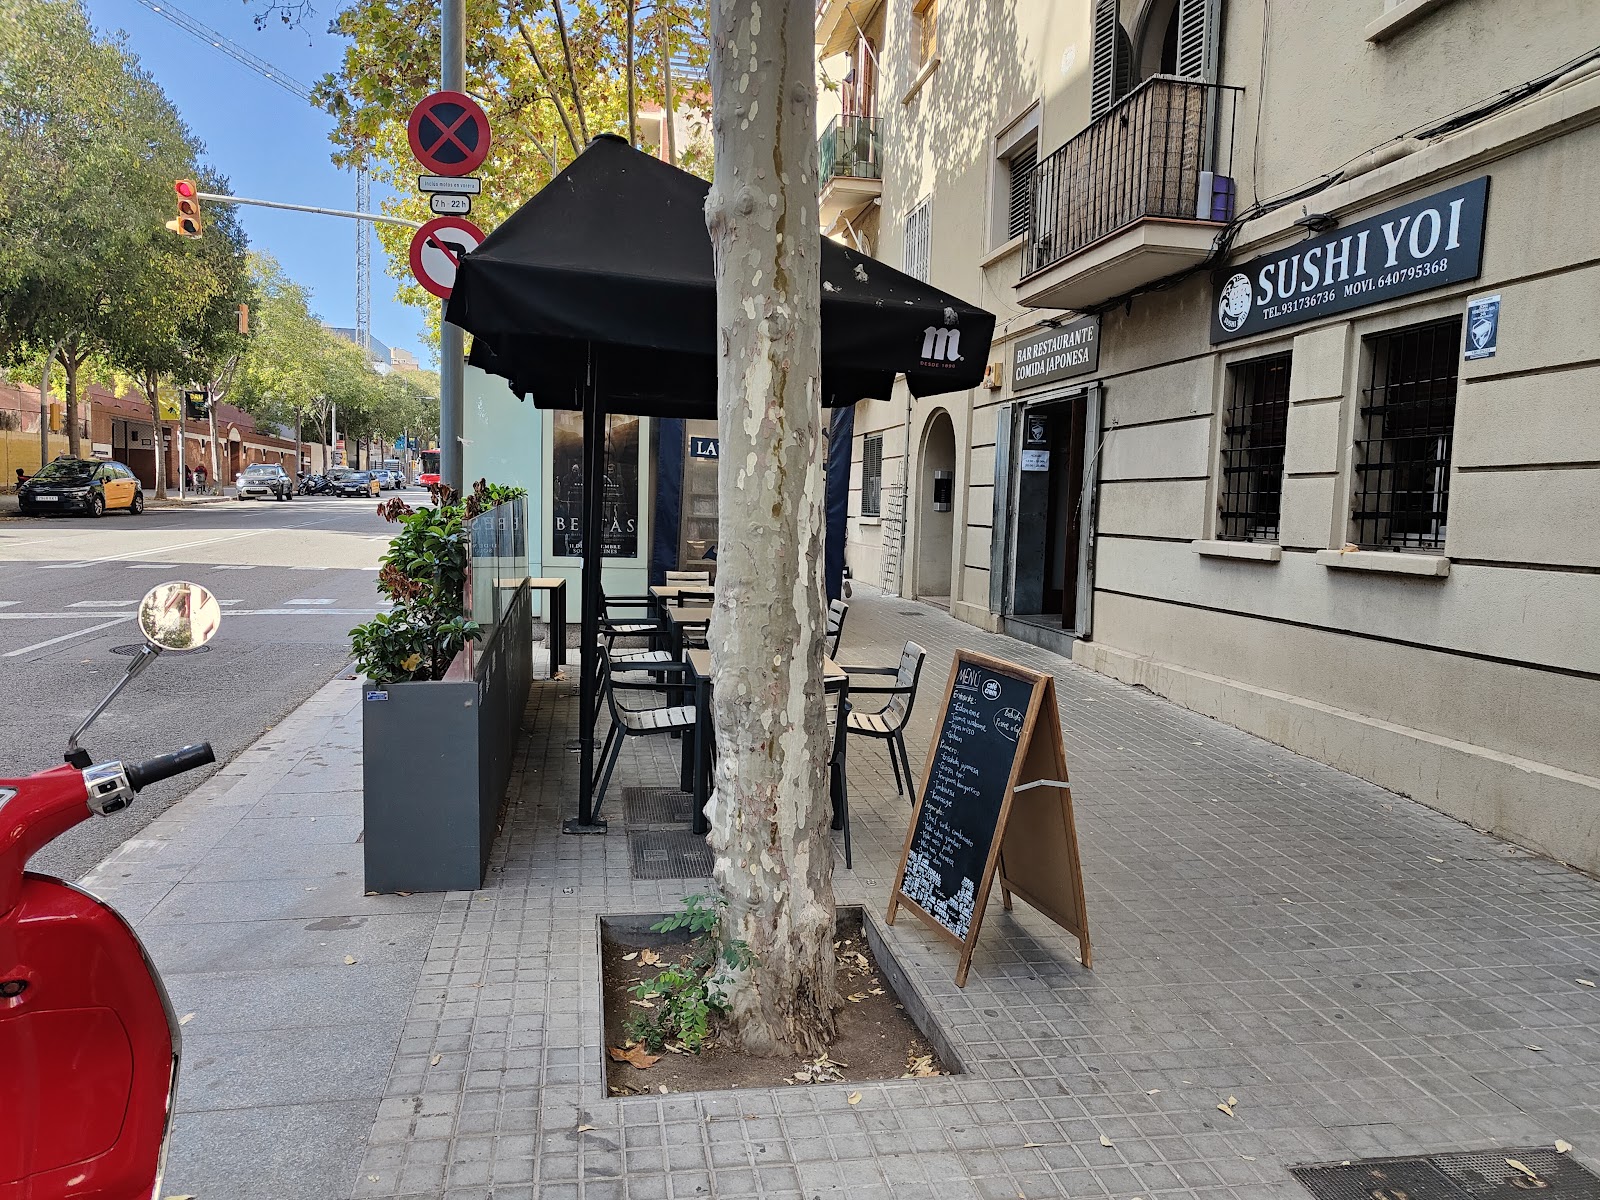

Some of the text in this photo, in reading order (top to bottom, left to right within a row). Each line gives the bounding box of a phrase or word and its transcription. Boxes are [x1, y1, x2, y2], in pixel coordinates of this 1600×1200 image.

[1256, 198, 1465, 307] SUSHI YOI
[1343, 282, 1376, 298] MOVI.
[1377, 258, 1448, 289] 640795368
[1016, 325, 1094, 364] BAR RESTAURANTE
[920, 360, 940, 368] DESDE
[1015, 346, 1090, 381] COMIDA JAPONESA
[696, 441, 719, 456] LA
[956, 667, 981, 688] MENÚ
